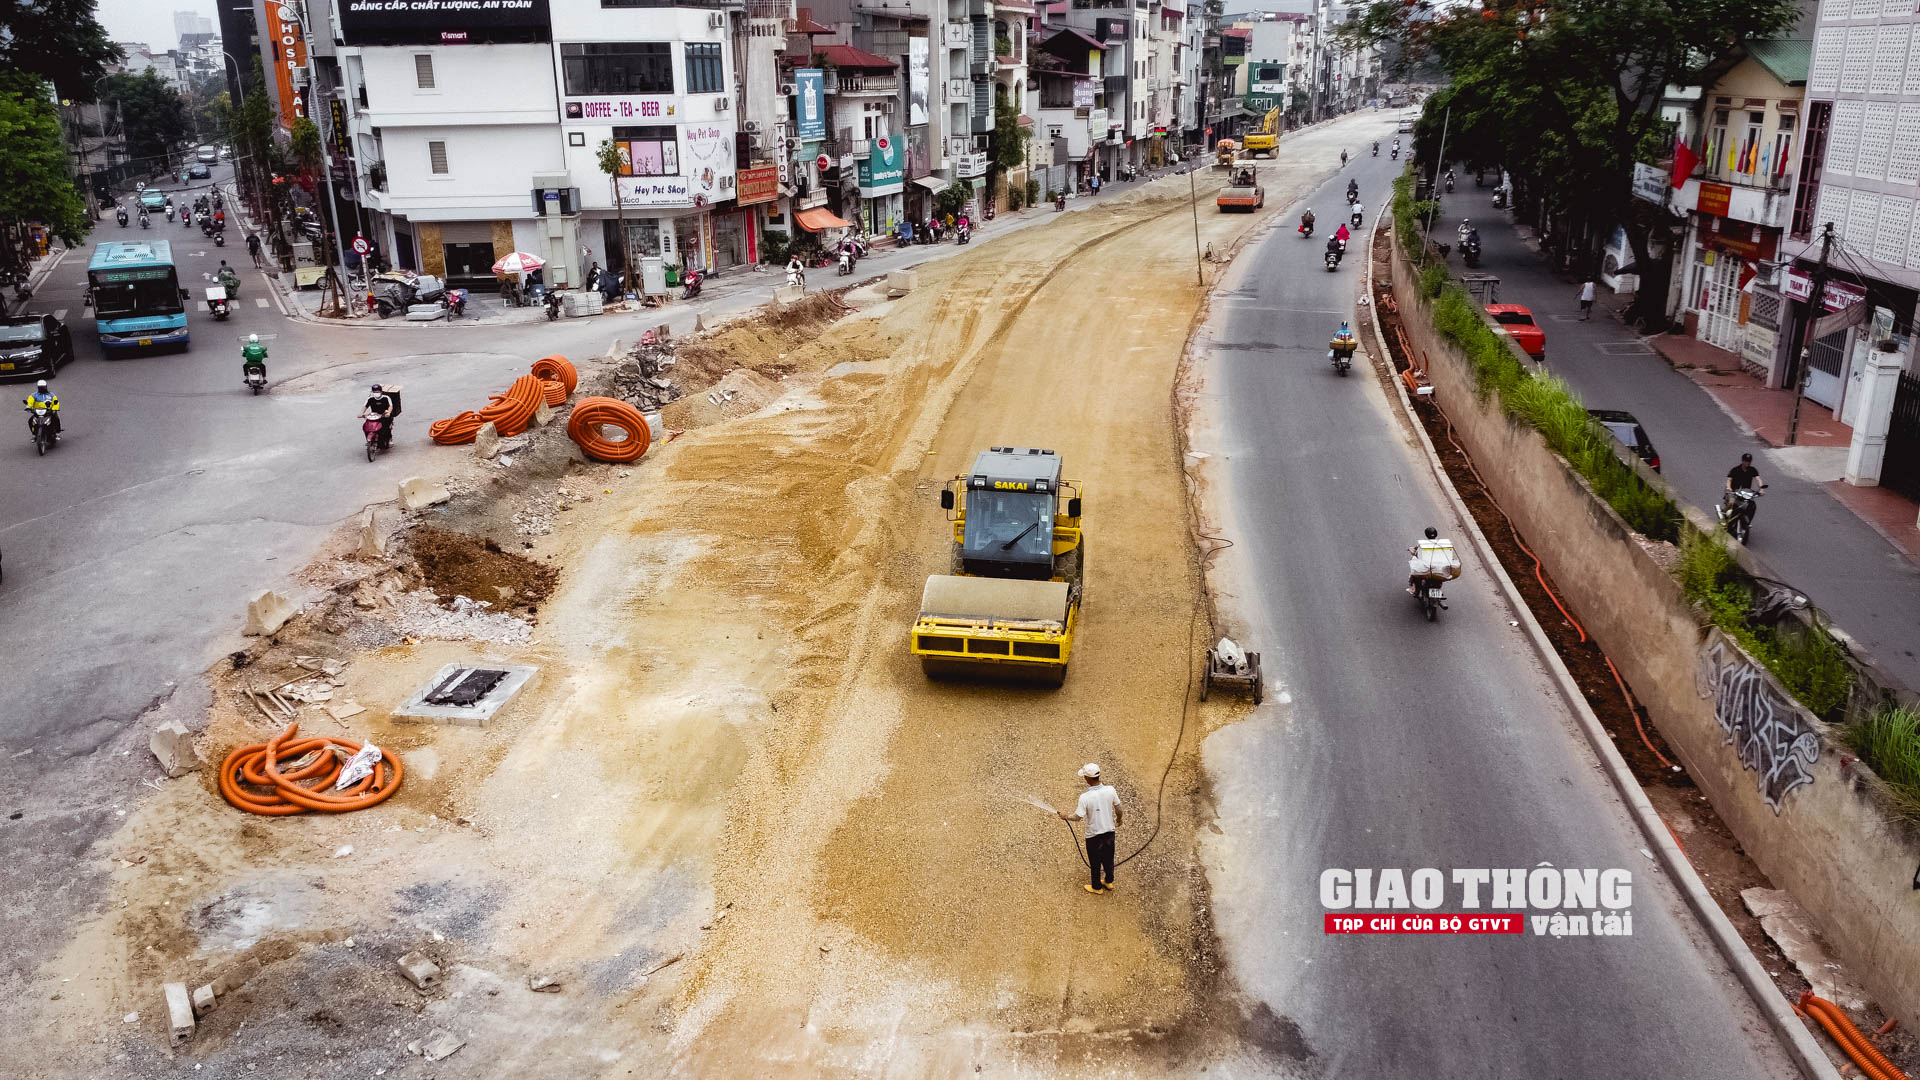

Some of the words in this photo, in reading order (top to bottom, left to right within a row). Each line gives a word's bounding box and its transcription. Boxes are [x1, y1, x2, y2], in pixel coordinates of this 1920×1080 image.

[482, 0, 500, 9] AN
[281, 24, 305, 118] HOSPAL
[585, 101, 611, 118] COFFEE
[619, 101, 633, 117] TEA
[641, 100, 660, 117] BEER
[776, 125, 787, 182] TATTOO
[634, 185, 650, 196] Hey
[652, 185, 665, 194] Pet
[667, 184, 686, 195] Shop
[994, 481, 1028, 490] SAKAI
